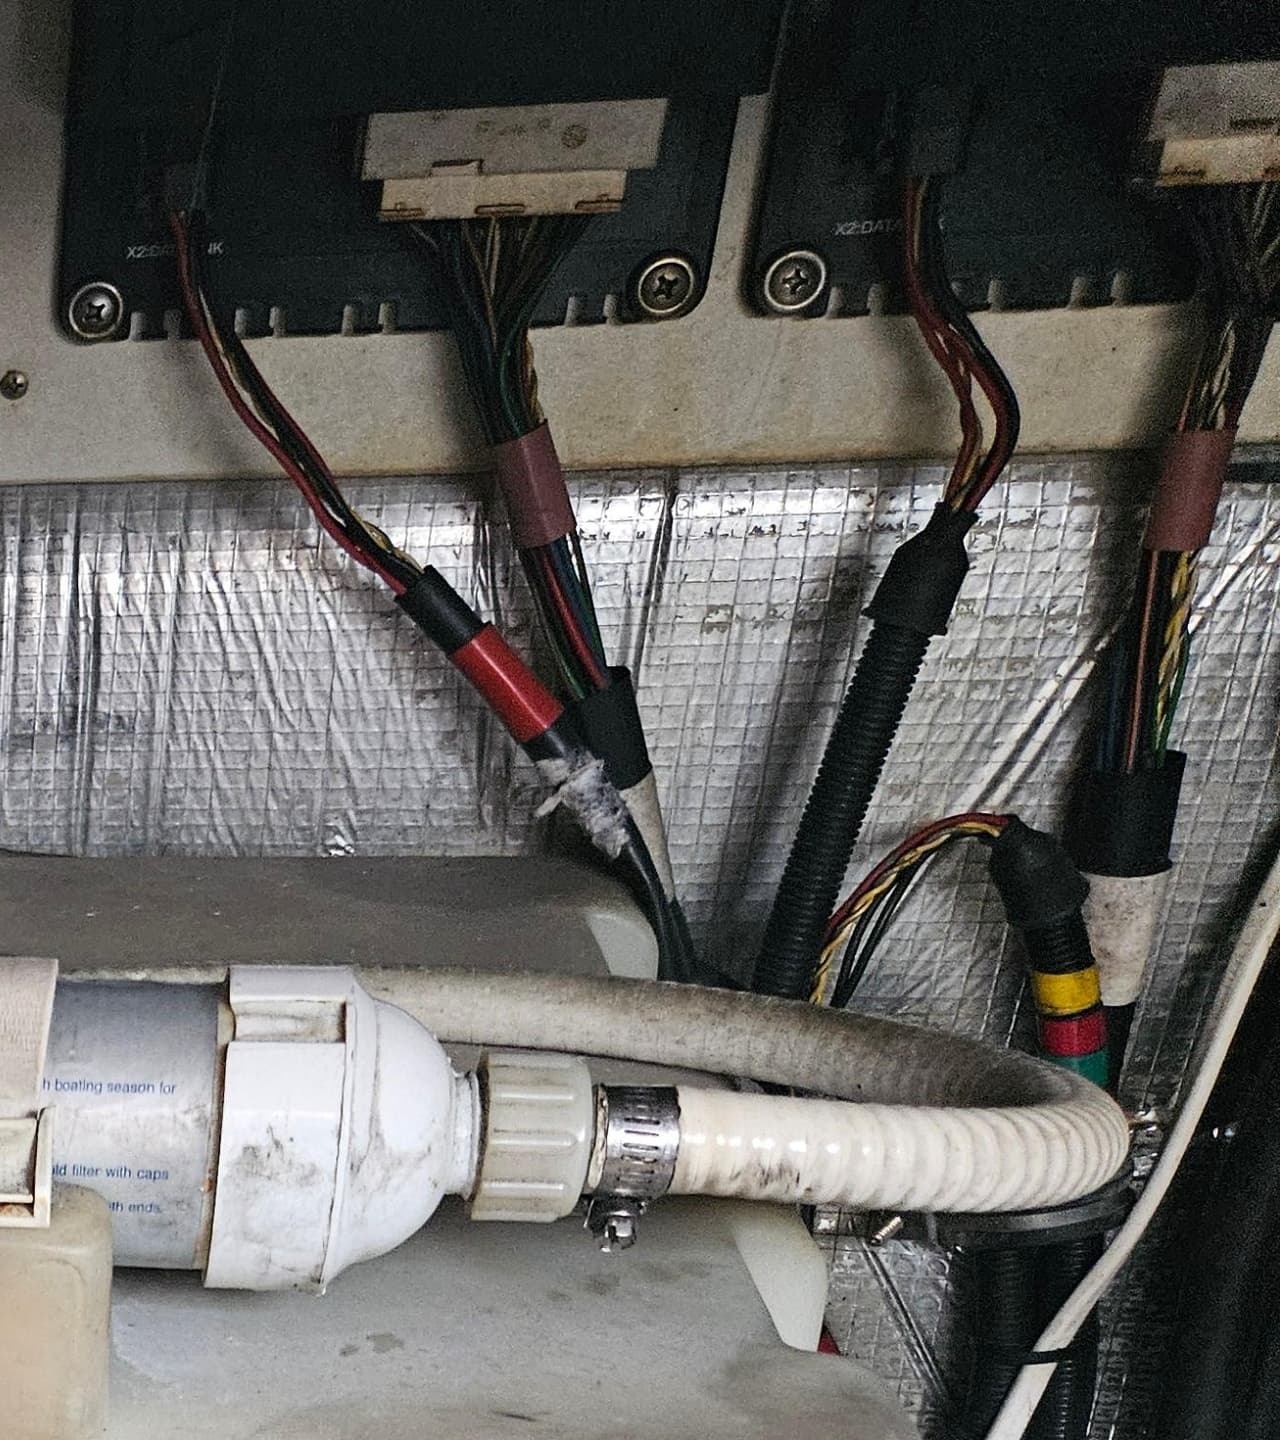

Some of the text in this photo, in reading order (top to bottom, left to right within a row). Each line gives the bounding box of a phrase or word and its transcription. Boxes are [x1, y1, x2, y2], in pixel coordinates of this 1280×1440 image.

[55, 1078, 103, 1094] boating
[107, 1082, 155, 1094] season
[160, 1080, 177, 1095] for
